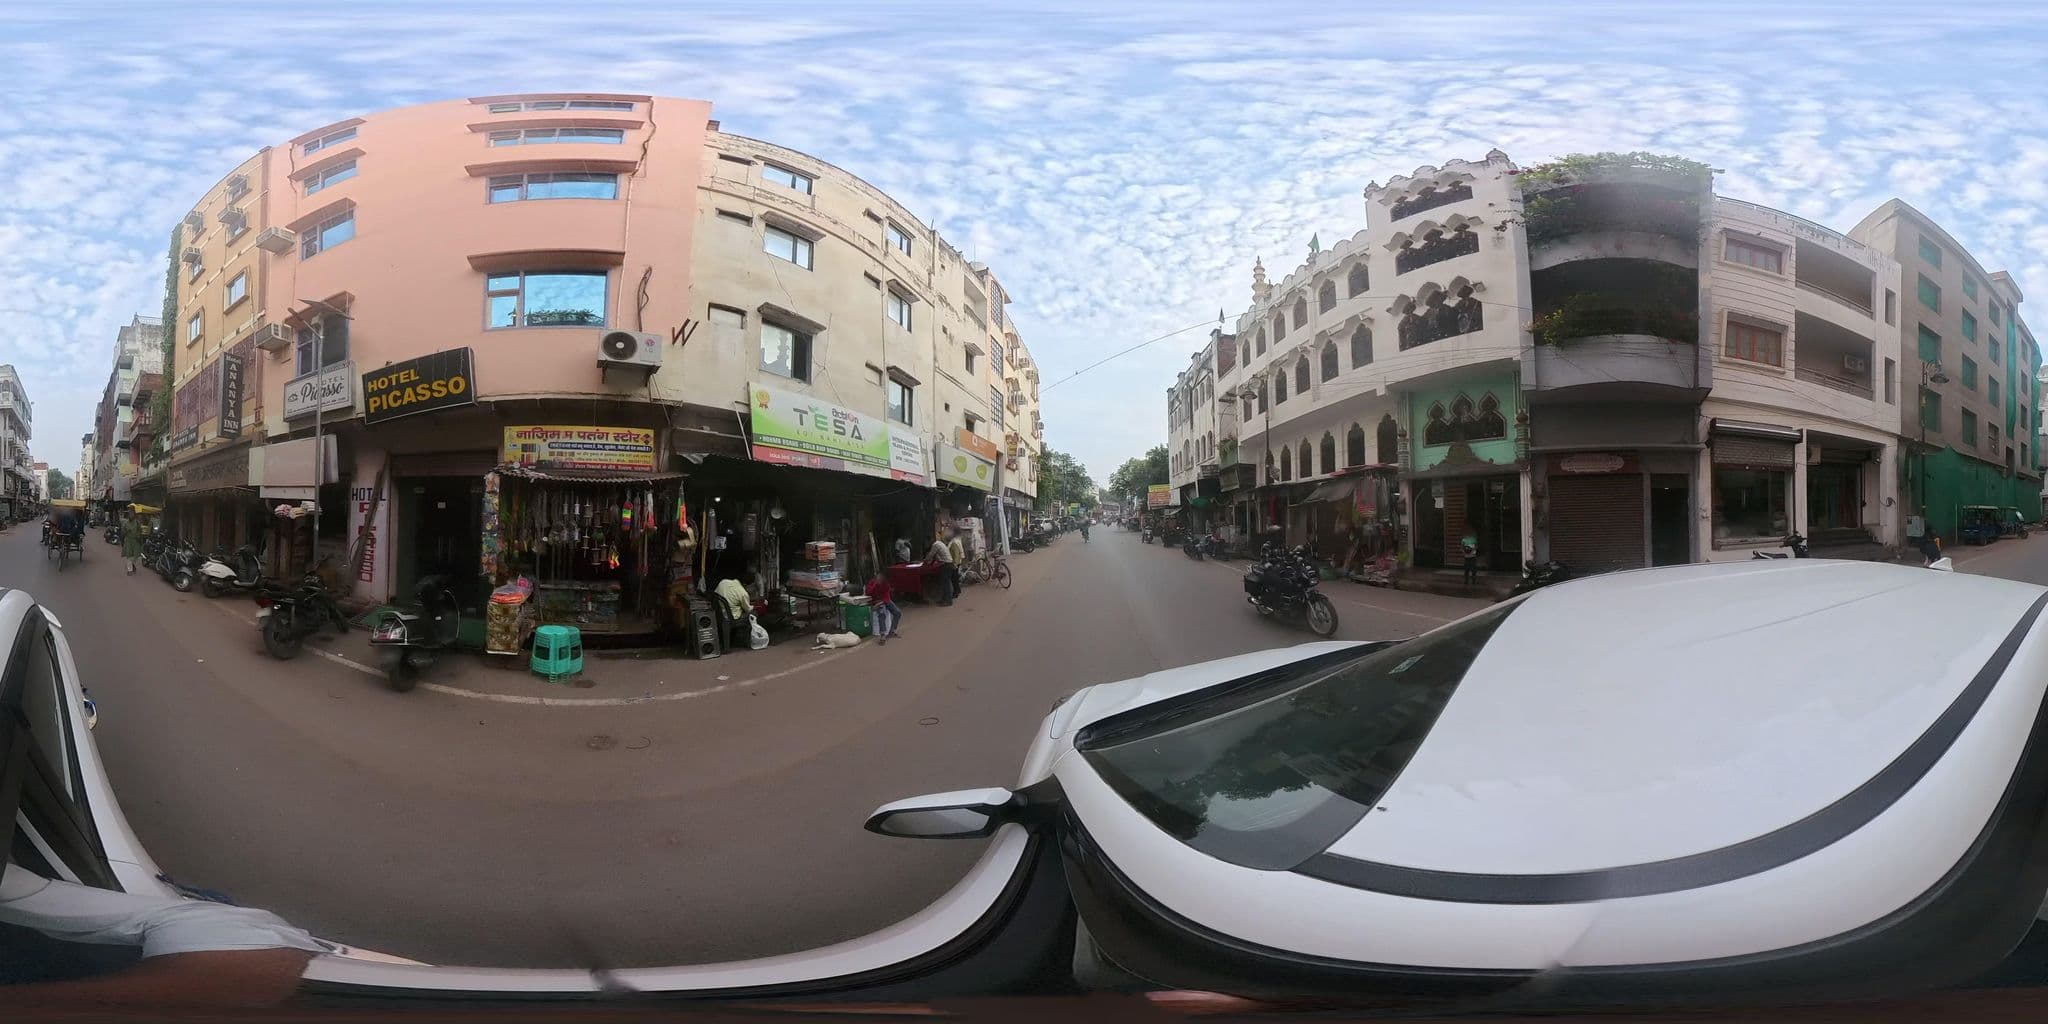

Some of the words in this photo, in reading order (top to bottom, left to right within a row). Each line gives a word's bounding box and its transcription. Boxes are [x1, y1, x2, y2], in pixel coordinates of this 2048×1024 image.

[228, 363, 238, 418] ANANYA
[368, 369, 420, 393] HOTEL
[369, 376, 466, 413] PICASSO
[224, 419, 239, 430] INN
[793, 408, 863, 440] TESA
[352, 487, 387, 501] HOTL
